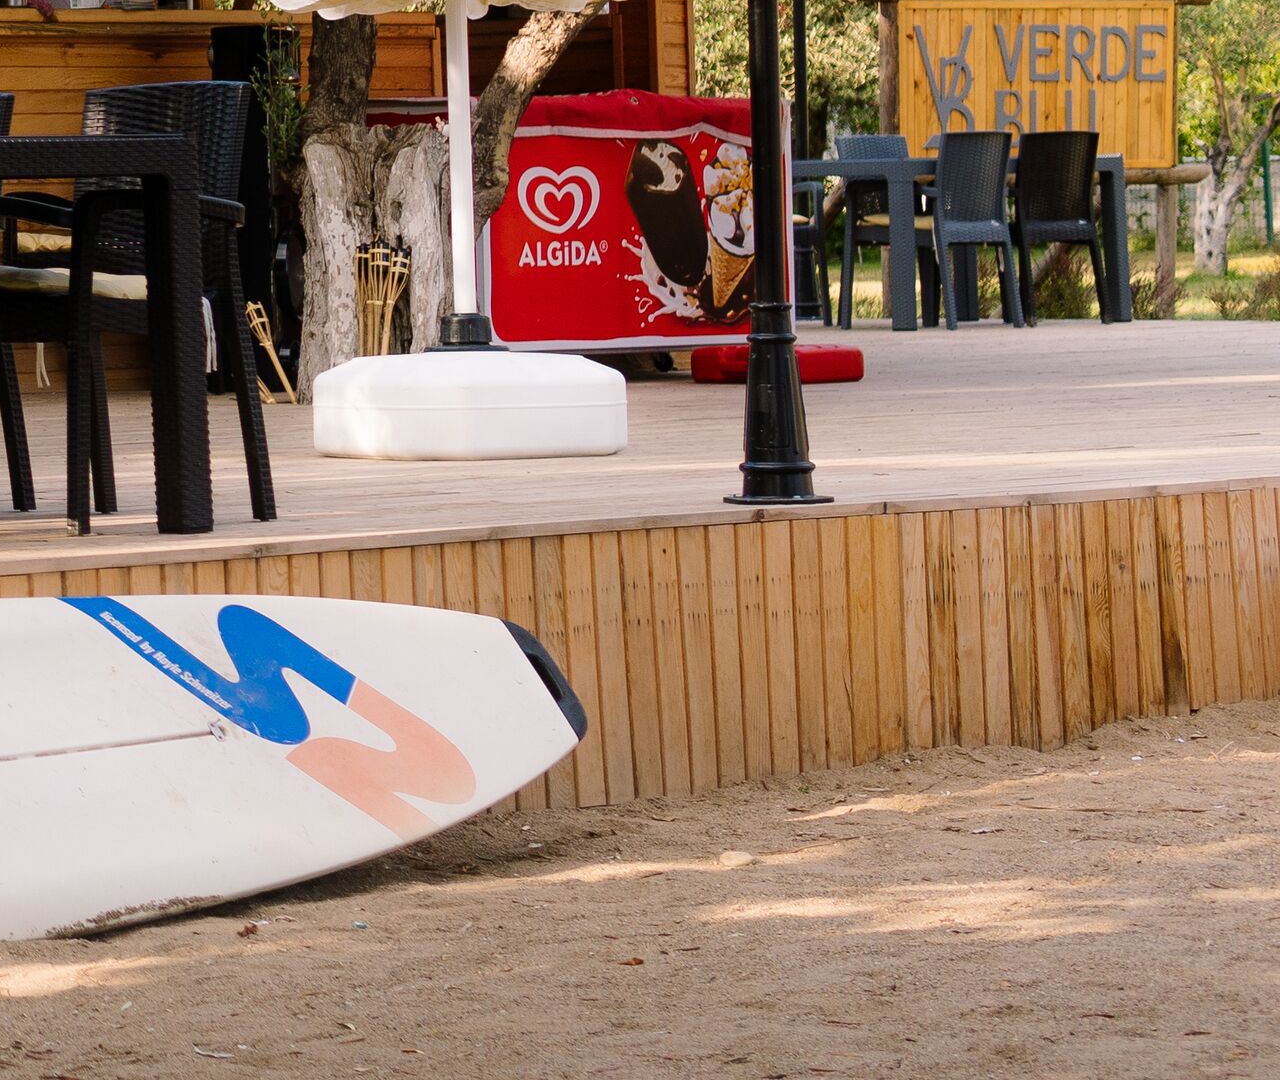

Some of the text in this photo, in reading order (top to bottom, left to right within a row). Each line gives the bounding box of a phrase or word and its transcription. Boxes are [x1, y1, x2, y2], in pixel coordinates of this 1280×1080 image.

[994, 24, 1167, 82] VERDE
[99, 610, 233, 710] licensed by Hoyle Schweitzer
